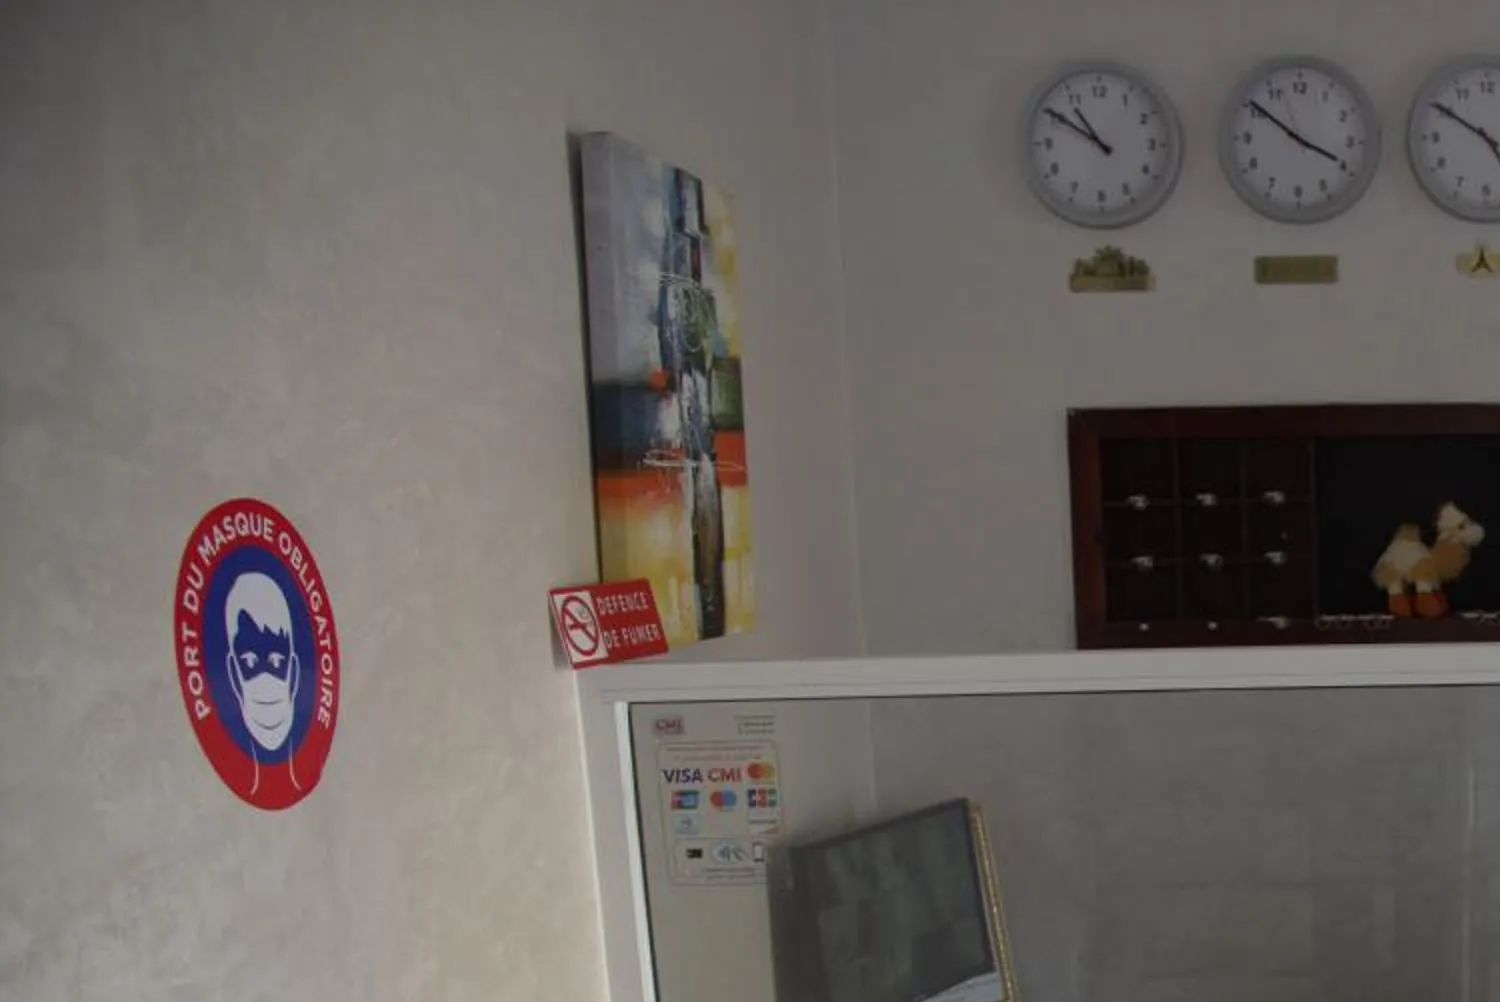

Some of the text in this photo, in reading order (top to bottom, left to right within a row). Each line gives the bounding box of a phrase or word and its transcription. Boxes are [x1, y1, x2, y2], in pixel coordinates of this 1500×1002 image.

[1092, 86, 1107, 97] 12
[1293, 82, 1307, 94] 12
[1480, 81, 1495, 93] 12
[182, 512, 333, 730] PORT DU MASQUE OBLIGATOIRE
[604, 623, 662, 649] DE FUMER
[662, 767, 743, 784] VISA CMI
